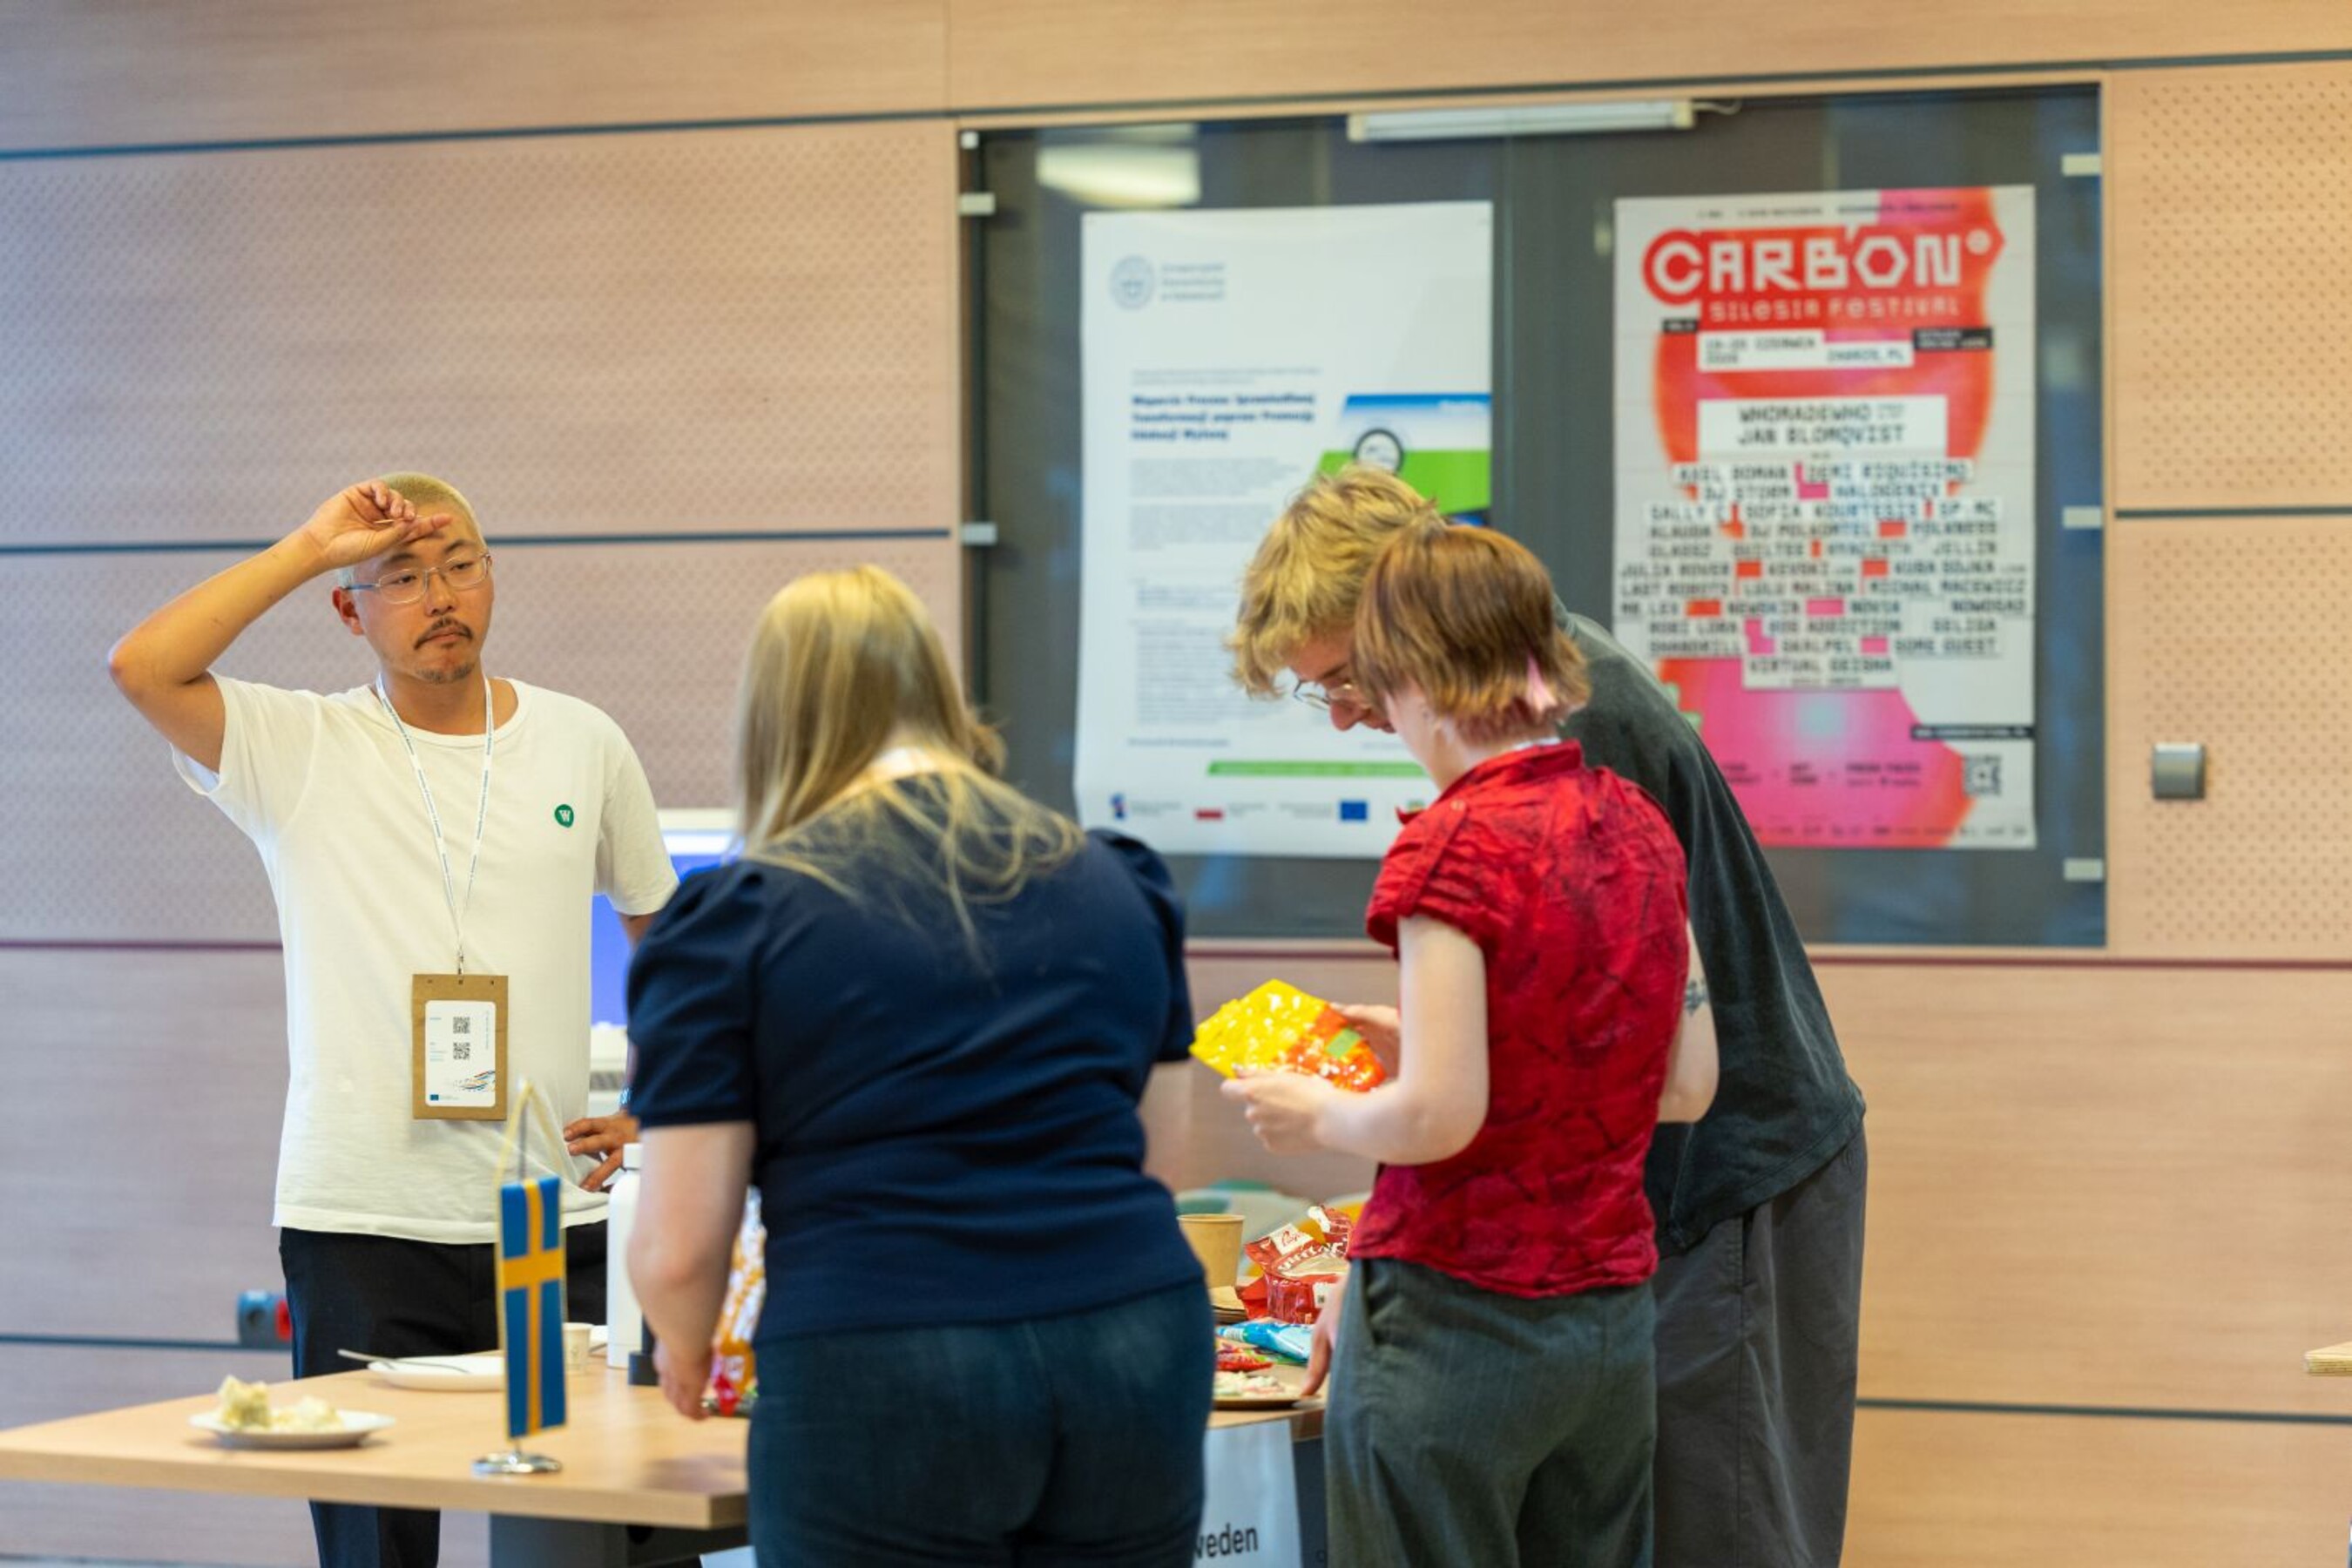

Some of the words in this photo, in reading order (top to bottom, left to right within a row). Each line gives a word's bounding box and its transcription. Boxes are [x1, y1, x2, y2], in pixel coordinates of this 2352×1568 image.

[1652, 234, 1960, 294] CARBON
[1710, 301, 1819, 321] SILESIA
[1829, 296, 1960, 319] FESTIVAL
